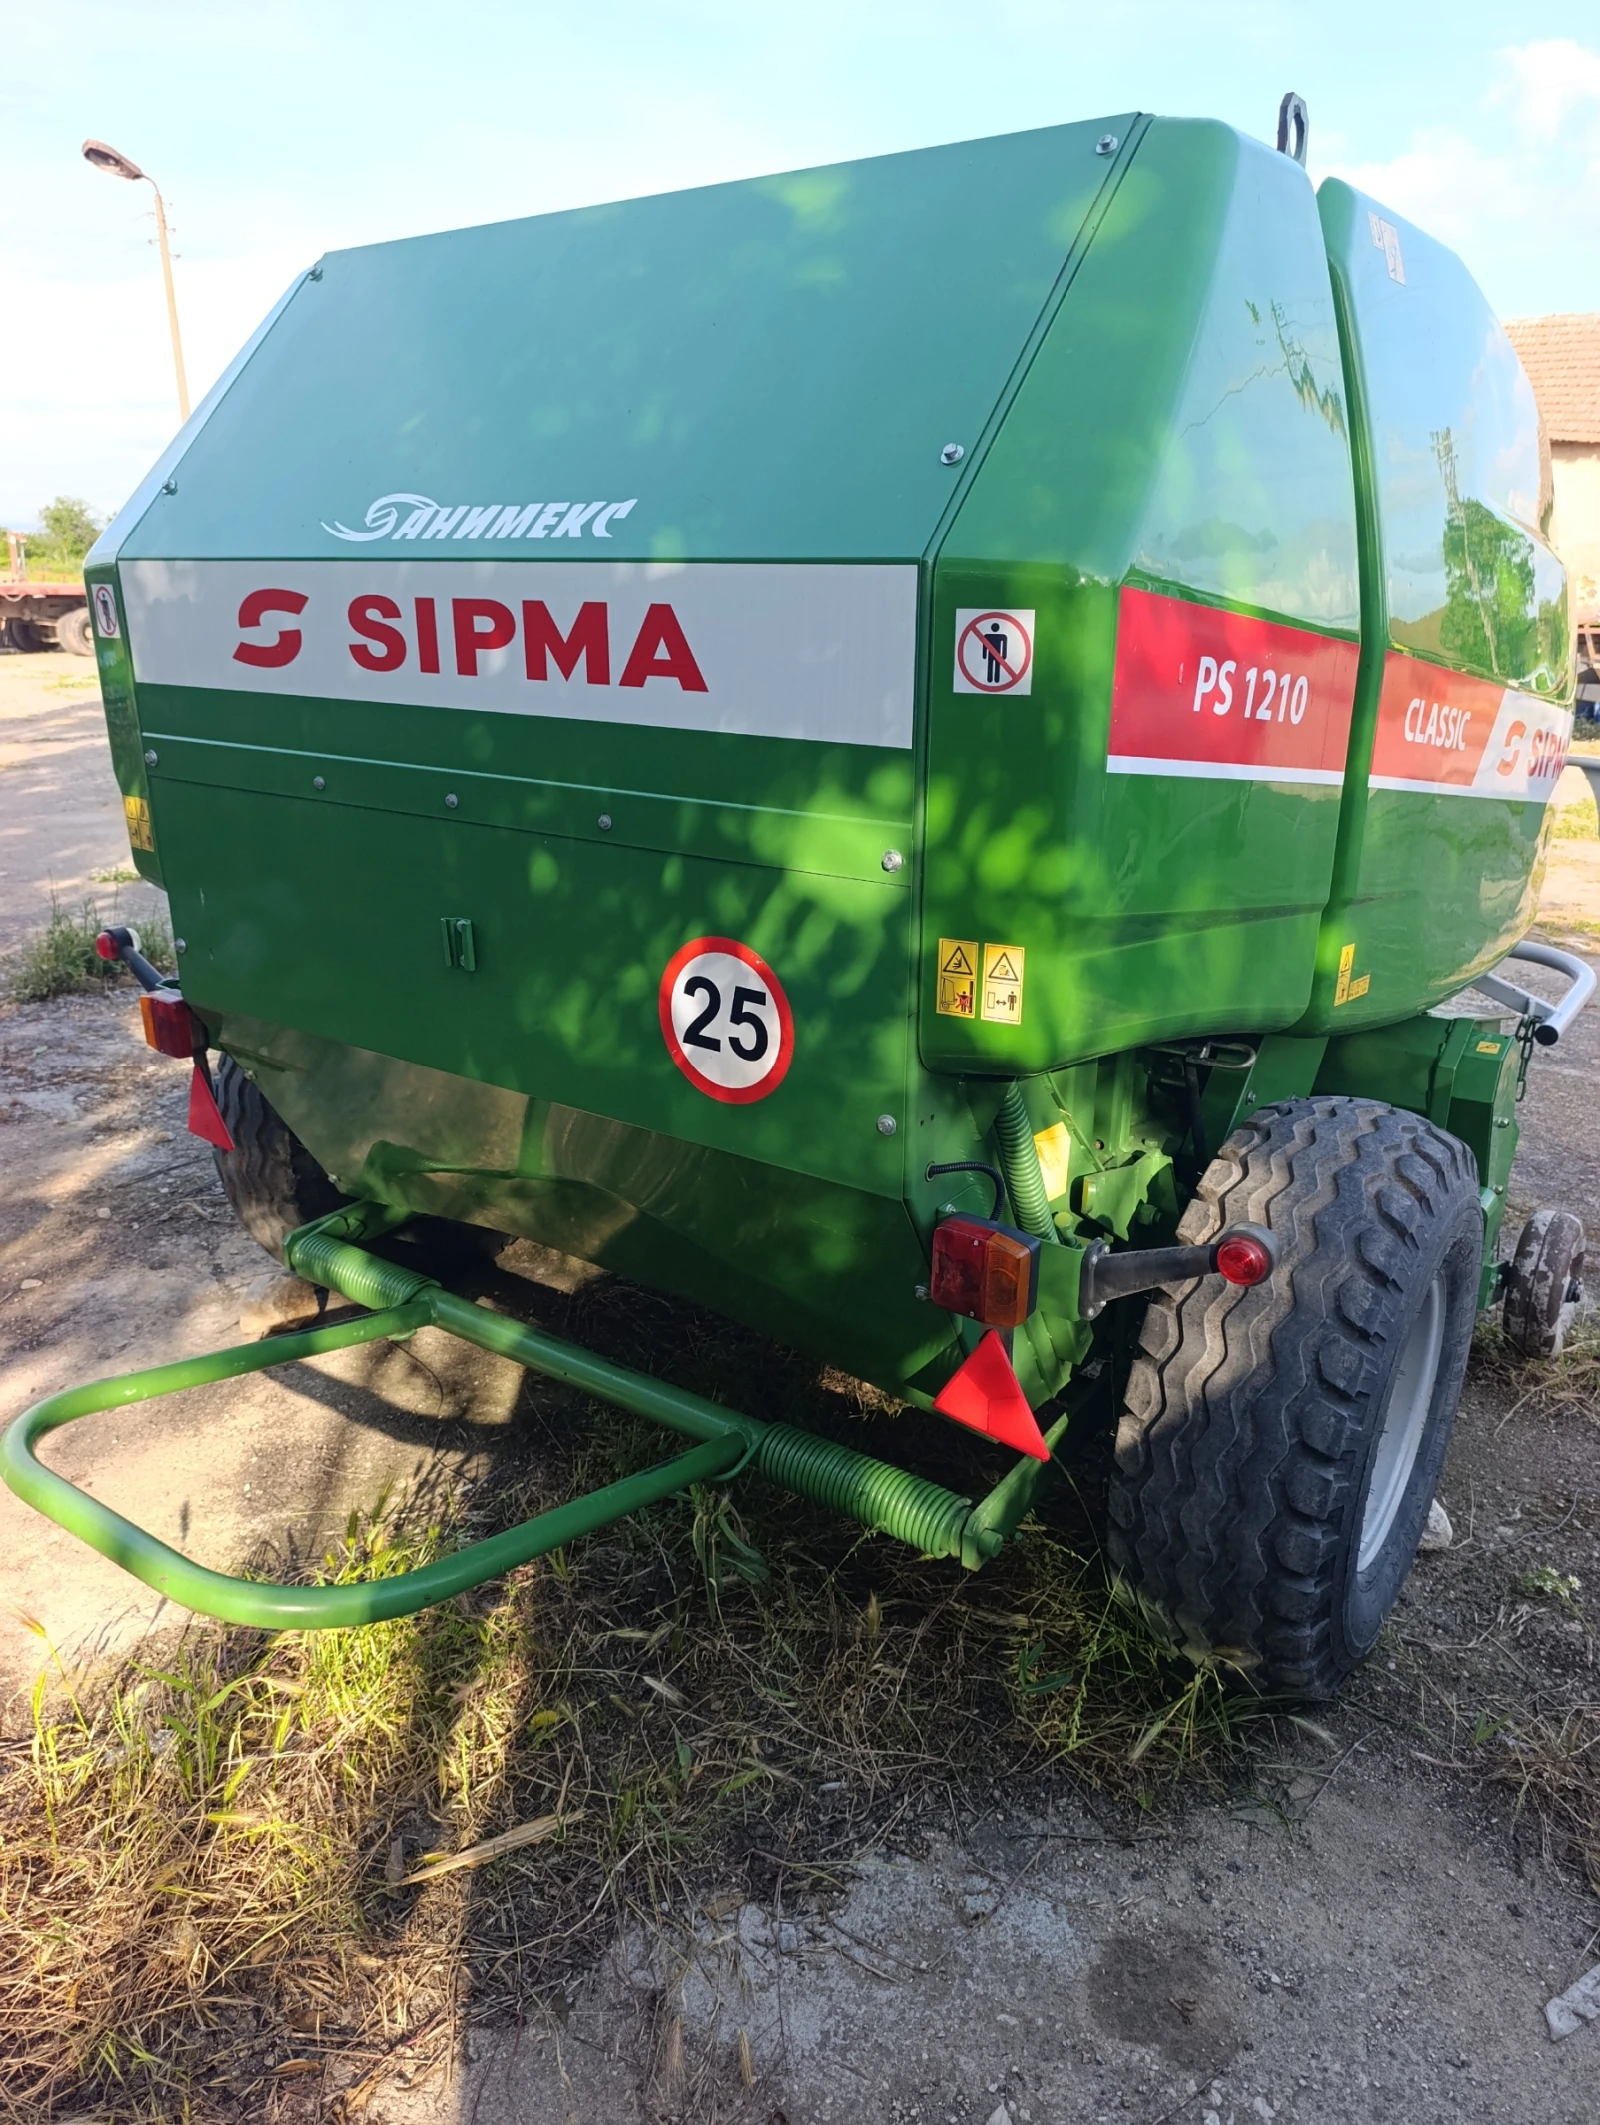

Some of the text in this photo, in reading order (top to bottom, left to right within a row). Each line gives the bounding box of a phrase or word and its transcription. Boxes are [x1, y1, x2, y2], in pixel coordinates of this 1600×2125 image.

[347, 593, 710, 693] SIPMA
[1192, 655, 1309, 725] PS 1210
[1404, 697, 1472, 751] CLASSIC
[1527, 728, 1569, 779] SIPM
[682, 975, 769, 1062] 25
